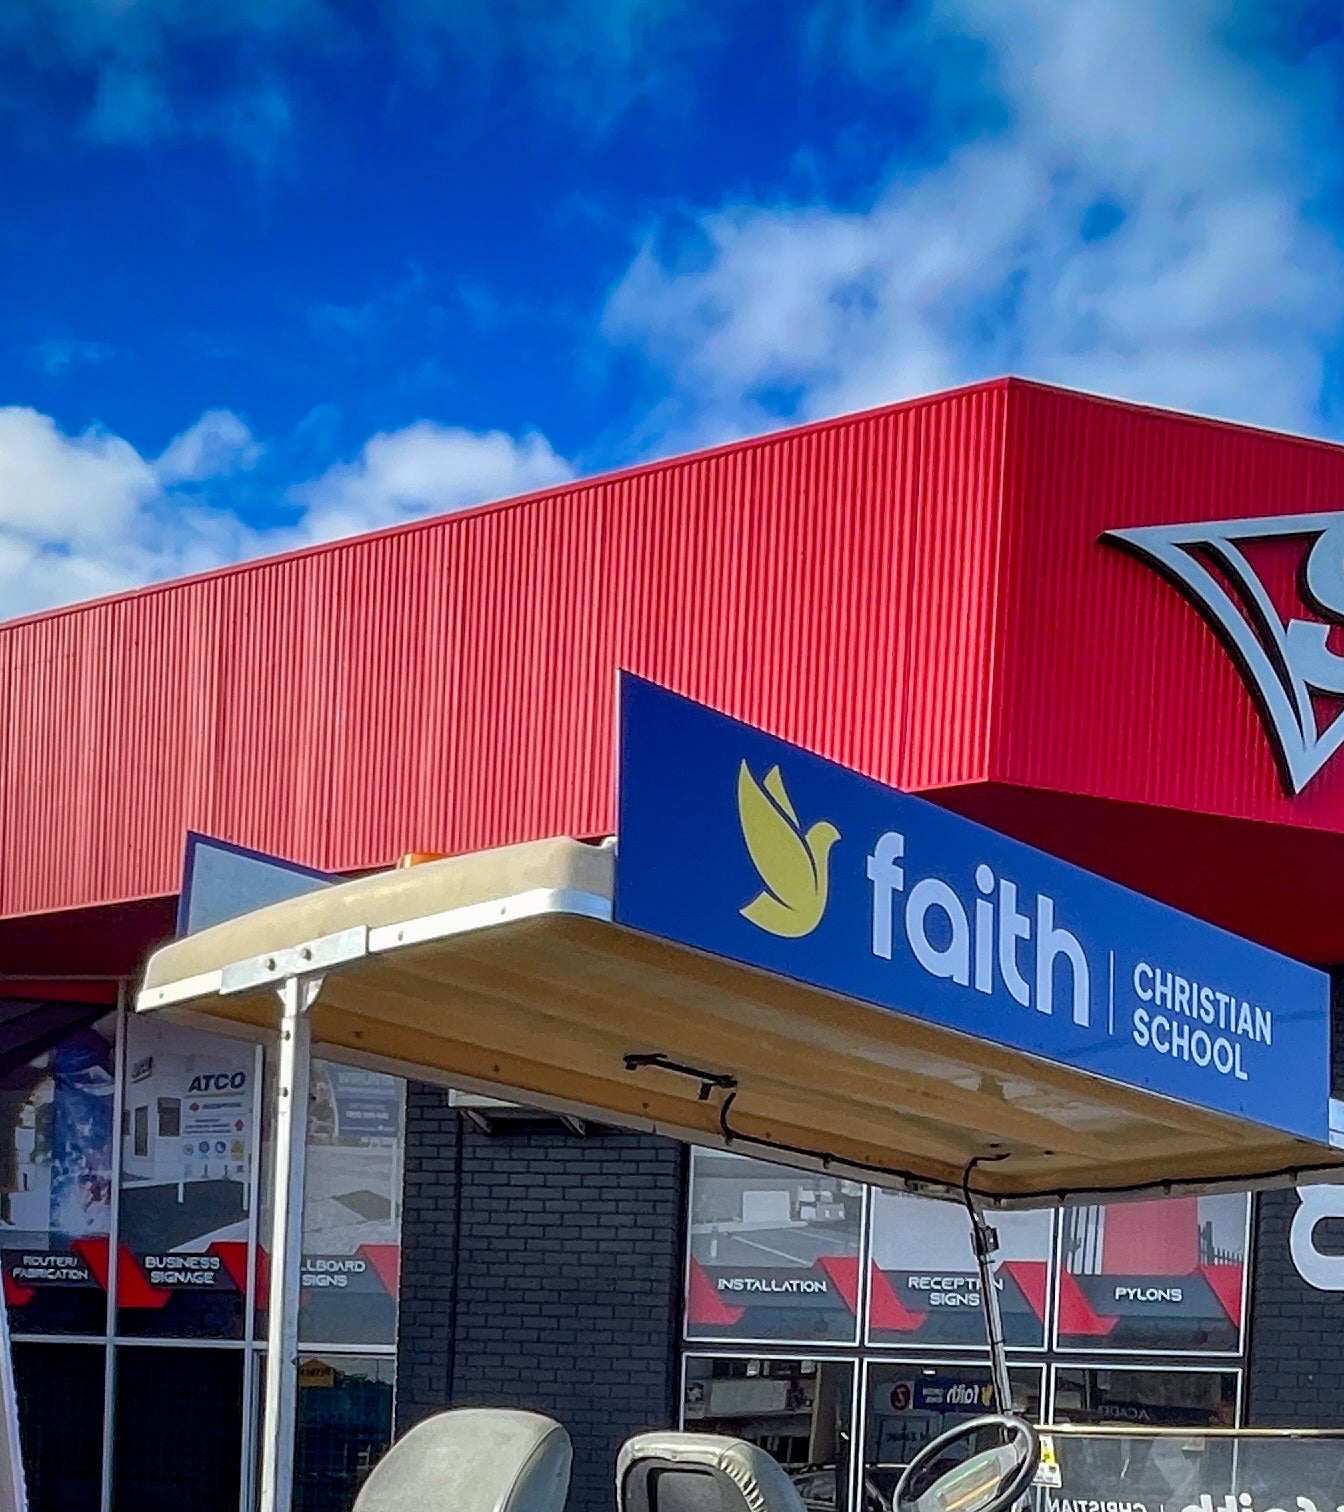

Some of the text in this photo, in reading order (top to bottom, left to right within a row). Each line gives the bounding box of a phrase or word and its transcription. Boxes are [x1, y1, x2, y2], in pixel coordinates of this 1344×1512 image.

[866, 831, 1091, 1028] faith
[1133, 962, 1273, 1046] CHRISTIAN
[1132, 1008, 1249, 1081] SCHOOL
[188, 1072, 246, 1093] ATCO
[145, 1256, 220, 1270] BUSINESS
[150, 1271, 215, 1284] SIGNAGE
[302, 1274, 347, 1287] SIGNS
[717, 1277, 827, 1293] INSTALLATION
[908, 1276, 1004, 1291] RECEPTIN
[929, 1292, 980, 1306] SIGNS
[1114, 1286, 1183, 1303] PYLONS
